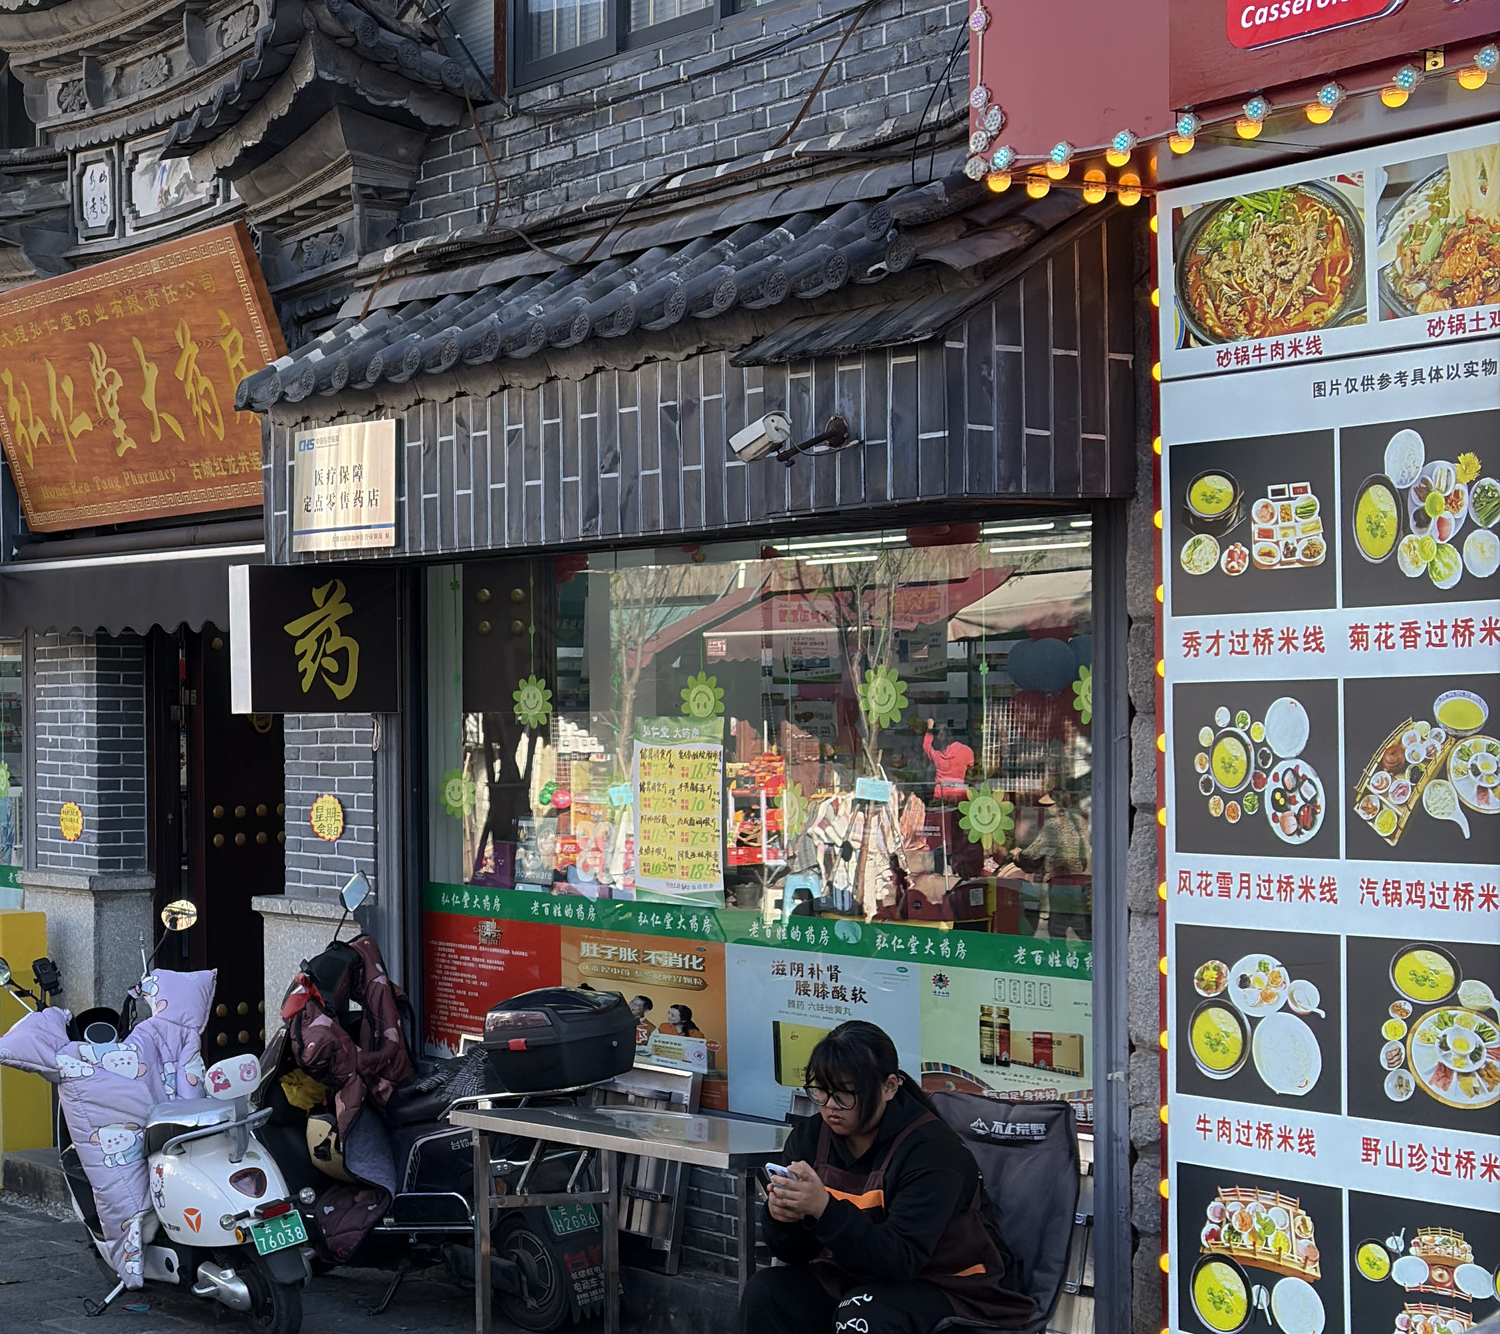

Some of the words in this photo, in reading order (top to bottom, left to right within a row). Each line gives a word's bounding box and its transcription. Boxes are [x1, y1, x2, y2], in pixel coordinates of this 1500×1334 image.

[1216, 335, 1324, 369] 砂锅牛肉米线
[1311, 357, 1499, 399] 图片仅供参考具体以实物
[298, 438, 315, 452] CHS
[93, 474, 121, 493] Tang
[123, 466, 177, 488] Pharmacy
[314, 463, 364, 487] 医疗保障
[303, 488, 379, 513] 定点零售药店
[283, 578, 362, 701] 药
[1181, 625, 1327, 659] 秀才过桥米线
[1348, 616, 1500, 654] 菊花香过桥米
[441, 891, 501, 912] 弘仁堂大药房
[1176, 870, 1339, 907] 风花雪月过桥米线
[1359, 877, 1499, 913] 汽锅鸡过桥米
[530, 902, 597, 921] 老百姓的药房
[638, 911, 712, 935] 弘仁堂大药房
[748, 919, 831, 946] 老百姓的药房
[580, 941, 639, 962] 肚子胀
[643, 950, 706, 971] 不消化
[876, 934, 968, 960] 弘仁堂大药房
[771, 960, 842, 982] 滋阴补肾
[794, 979, 868, 1005] 腰膝酸软
[807, 1002, 852, 1017] 六味地黄丸
[1195, 1113, 1317, 1158] 牛肉过桥米线
[1360, 1136, 1500, 1183] 野山珍过桥米
[280, 1219, 291, 1228] L
[258, 1226, 304, 1251] 76038
